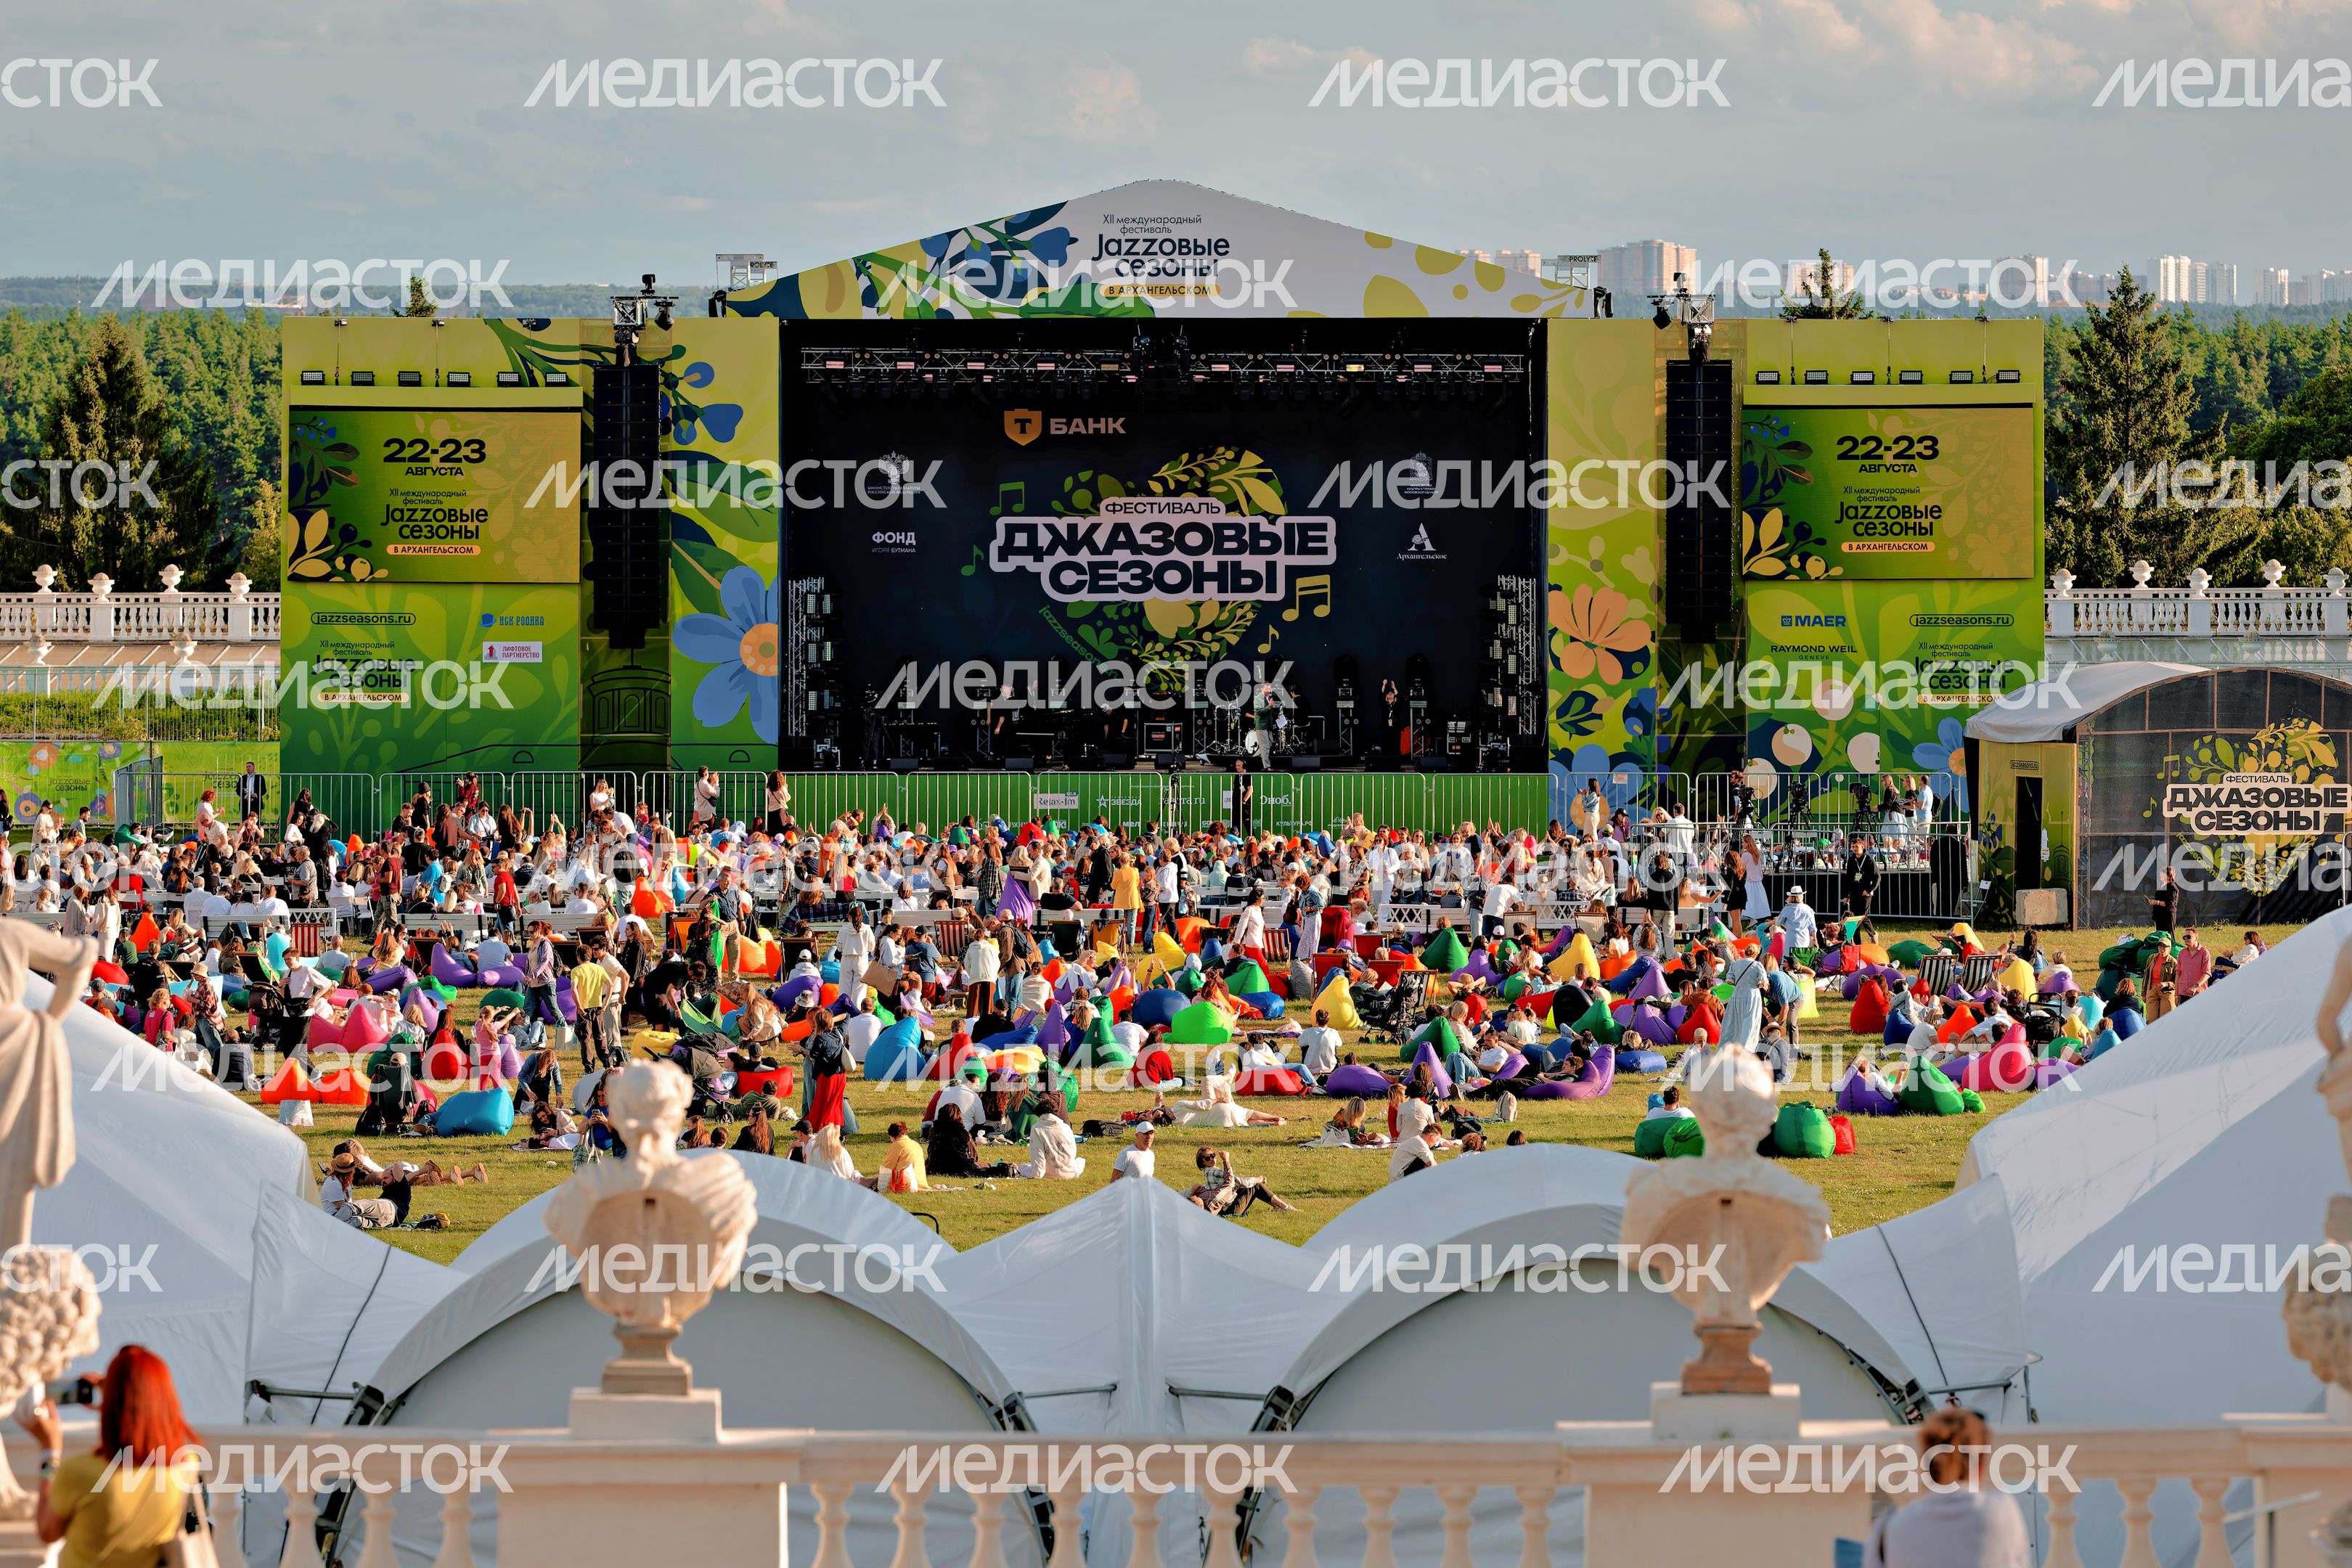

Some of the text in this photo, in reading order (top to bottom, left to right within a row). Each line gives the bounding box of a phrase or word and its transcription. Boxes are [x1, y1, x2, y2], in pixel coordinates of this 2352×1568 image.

[1116, 215, 1201, 226] международный
[1120, 224, 1172, 236] фестиваль
[1115, 258, 1218, 277] сезоны
[1109, 286, 1211, 295] В АРХАНГЕЛЬСКОМ
[1050, 417, 1126, 434] БАНК
[383, 438, 486, 464] 22-23
[1837, 436, 1940, 460] 22-23
[405, 466, 464, 476] АВГУСТА
[1858, 464, 1918, 473] АВГУСТА
[400, 489, 467, 499] международный
[1854, 486, 1921, 497] международный
[402, 497, 444, 507] фестиваль
[1857, 494, 1898, 504] фестиваль
[1105, 501, 1221, 515] ФЕСТИВАЛЬ
[398, 524, 479, 539] сезоны
[1853, 521, 1934, 537] сезоны
[872, 531, 916, 546] ФОНД
[997, 521, 1328, 563] ДЖАЗОВЫЕ
[1048, 560, 1278, 595] СЕЗОНЫ
[317, 613, 411, 624] jazzseasons.ru
[516, 616, 544, 626] РОДИНА
[1795, 616, 1847, 627] MAER
[1915, 615, 2009, 626] jazzseasons.ru
[330, 641, 395, 650] международный
[1929, 642, 1993, 651] международный
[332, 648, 372, 656] фестиваль
[1932, 649, 1971, 658] фестиваль
[328, 674, 407, 688] сезоны
[1929, 675, 2006, 689] сезоны
[2168, 787, 2348, 812] ДЖАЗОВЫЕ
[2195, 810, 2320, 830] СЕЗОНЫ
